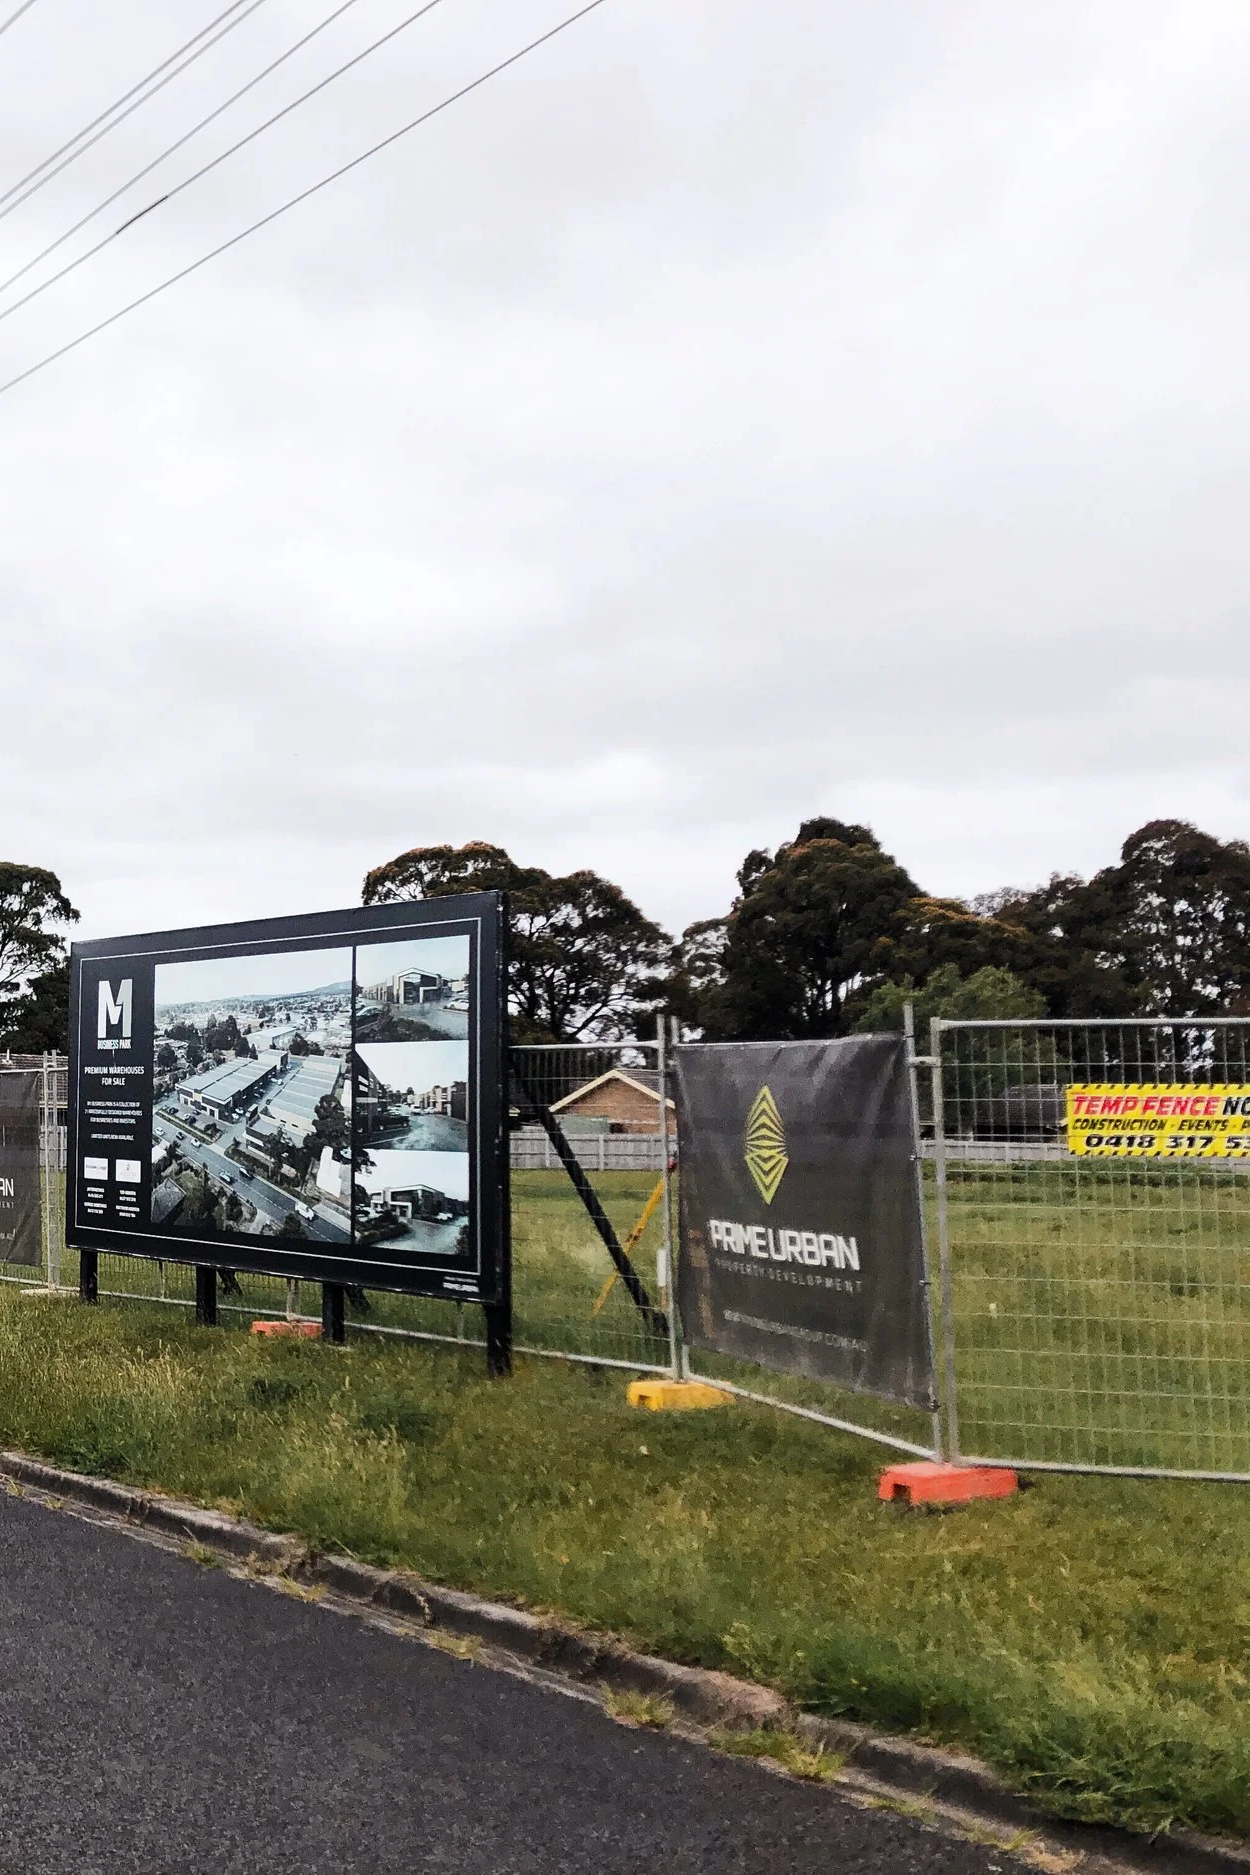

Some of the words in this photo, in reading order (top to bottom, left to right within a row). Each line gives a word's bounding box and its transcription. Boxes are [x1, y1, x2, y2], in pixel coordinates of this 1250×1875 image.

[84, 1066, 108, 1075] PREMIUM
[108, 1065, 145, 1075] WAREHOUSES
[101, 1077, 112, 1086] FOR
[112, 1077, 126, 1086] SALE
[1073, 1095, 1140, 1115] TEMP
[1140, 1096, 1221, 1116] FENCE
[1072, 1118, 1168, 1131] CONSTRUCTION
[1178, 1118, 1229, 1131] EVENTS
[1085, 1134, 1158, 1149] 0418
[1166, 1135, 1214, 1149] 317
[709, 1219, 861, 1271] PRIMEURBAN
